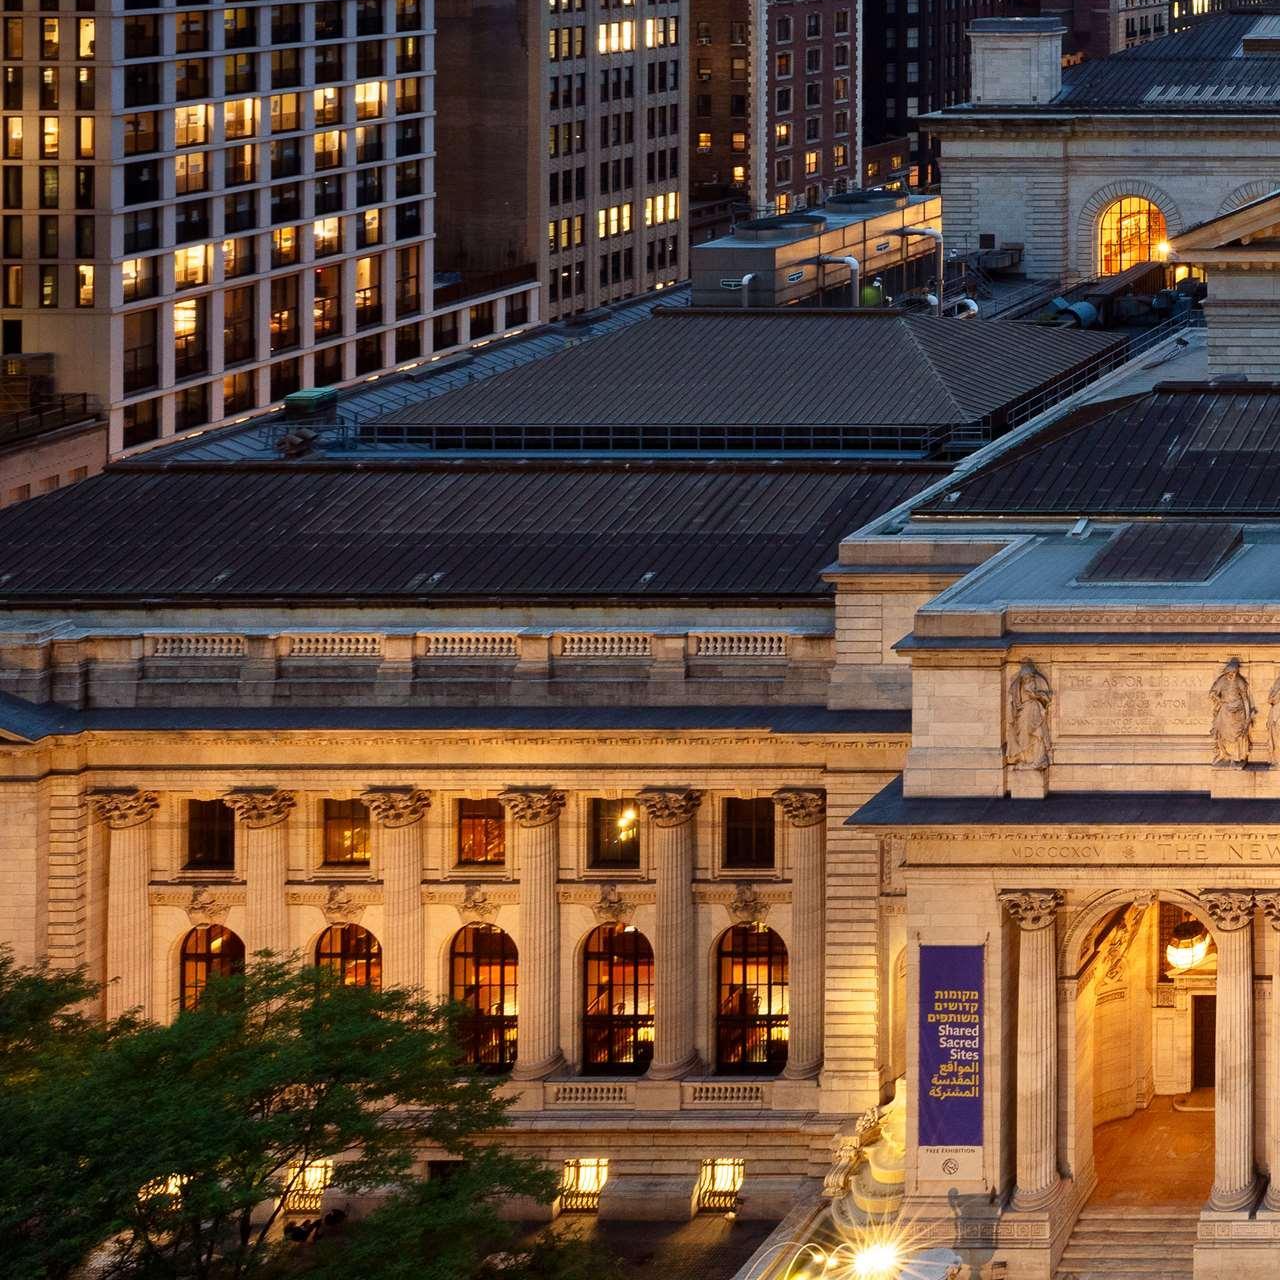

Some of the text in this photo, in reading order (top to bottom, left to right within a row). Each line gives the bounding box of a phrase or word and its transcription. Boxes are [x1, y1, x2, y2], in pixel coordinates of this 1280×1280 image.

[1068, 676, 1092, 688] THE
[1103, 676, 1143, 688] ASTOR
[1011, 847, 1104, 859] MDCCCXCV
[1158, 844, 1209, 861] THE
[938, 1024, 979, 1036] Shared
[939, 1037, 979, 1048] Sacred
[950, 1049, 979, 1060] Sites
